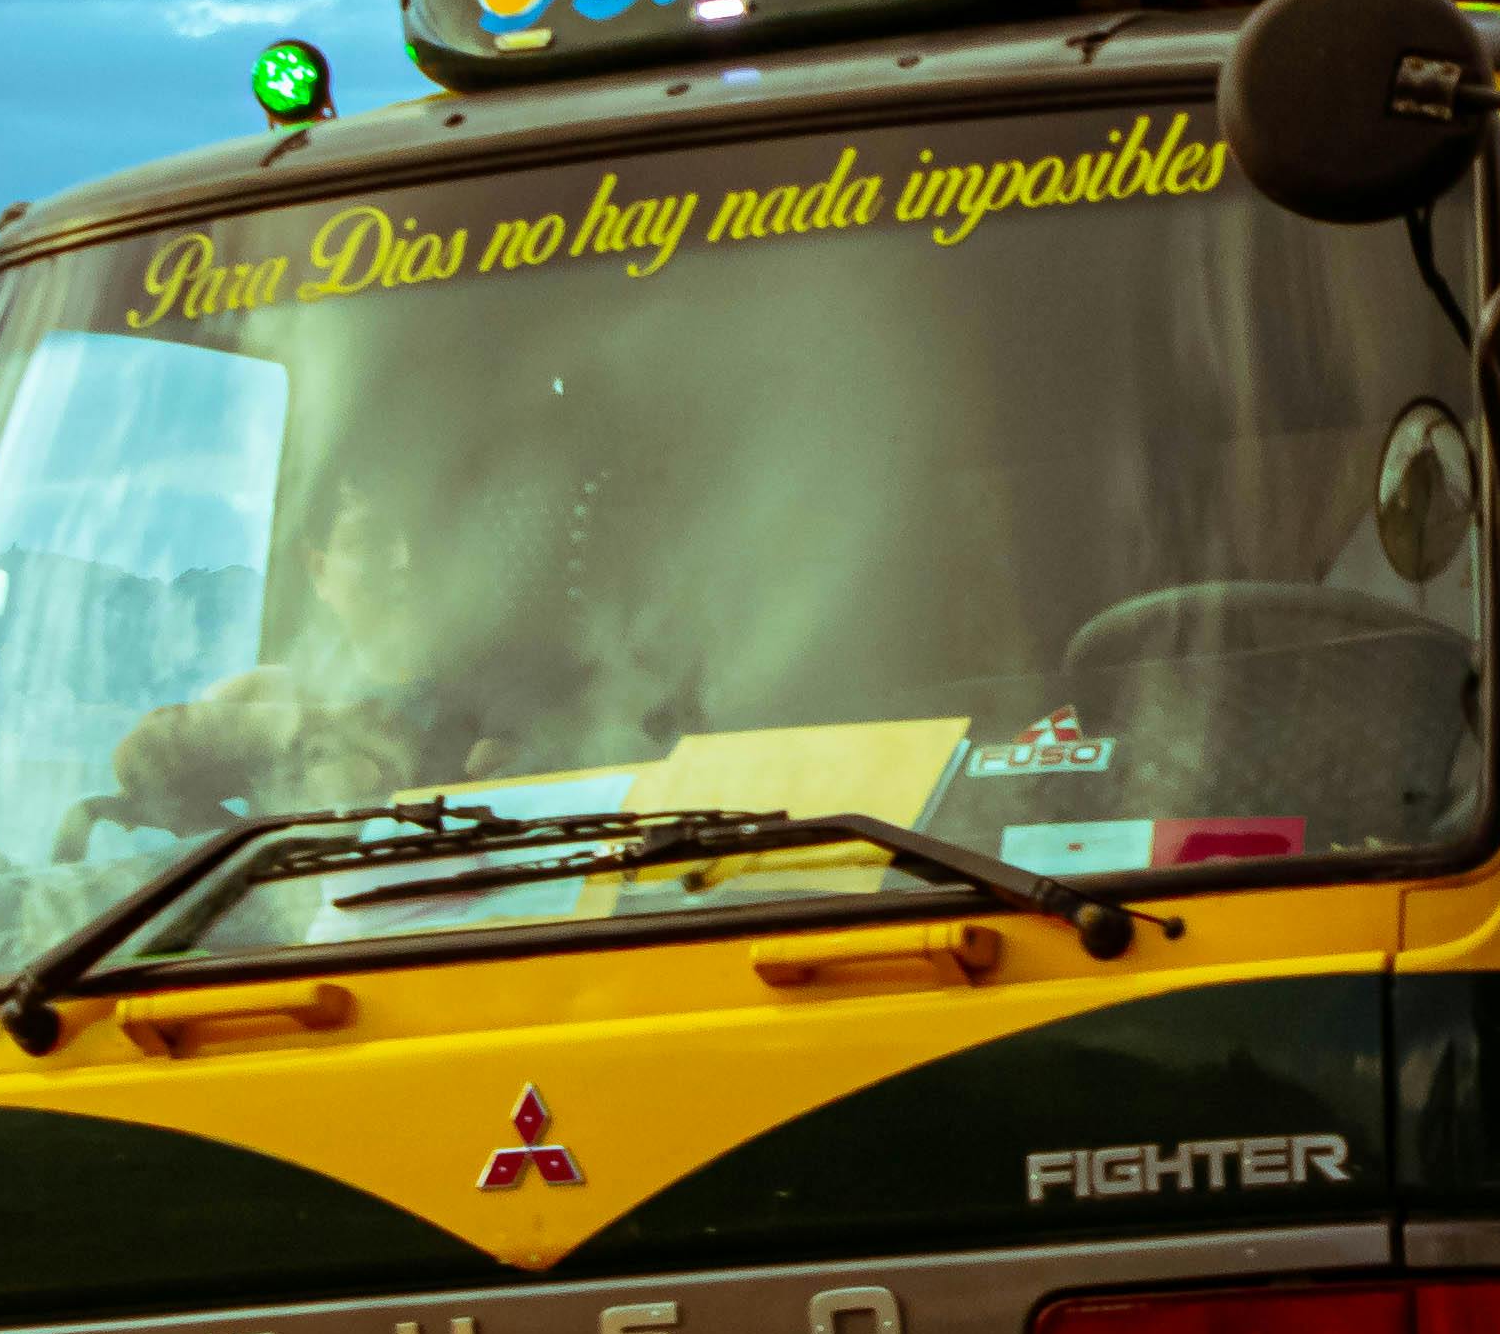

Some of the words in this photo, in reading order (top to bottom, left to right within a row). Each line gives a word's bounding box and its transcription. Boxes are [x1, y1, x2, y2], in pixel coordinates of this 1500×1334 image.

[127, 233, 288, 329] Para
[296, 205, 468, 301] Dios
[479, 214, 565, 272] no
[570, 174, 698, 278] hay
[707, 148, 883, 243] nada
[896, 112, 1228, 247] imposibles
[977, 743, 1103, 769] FUSO
[1026, 1133, 1352, 1204] FIGHTER
